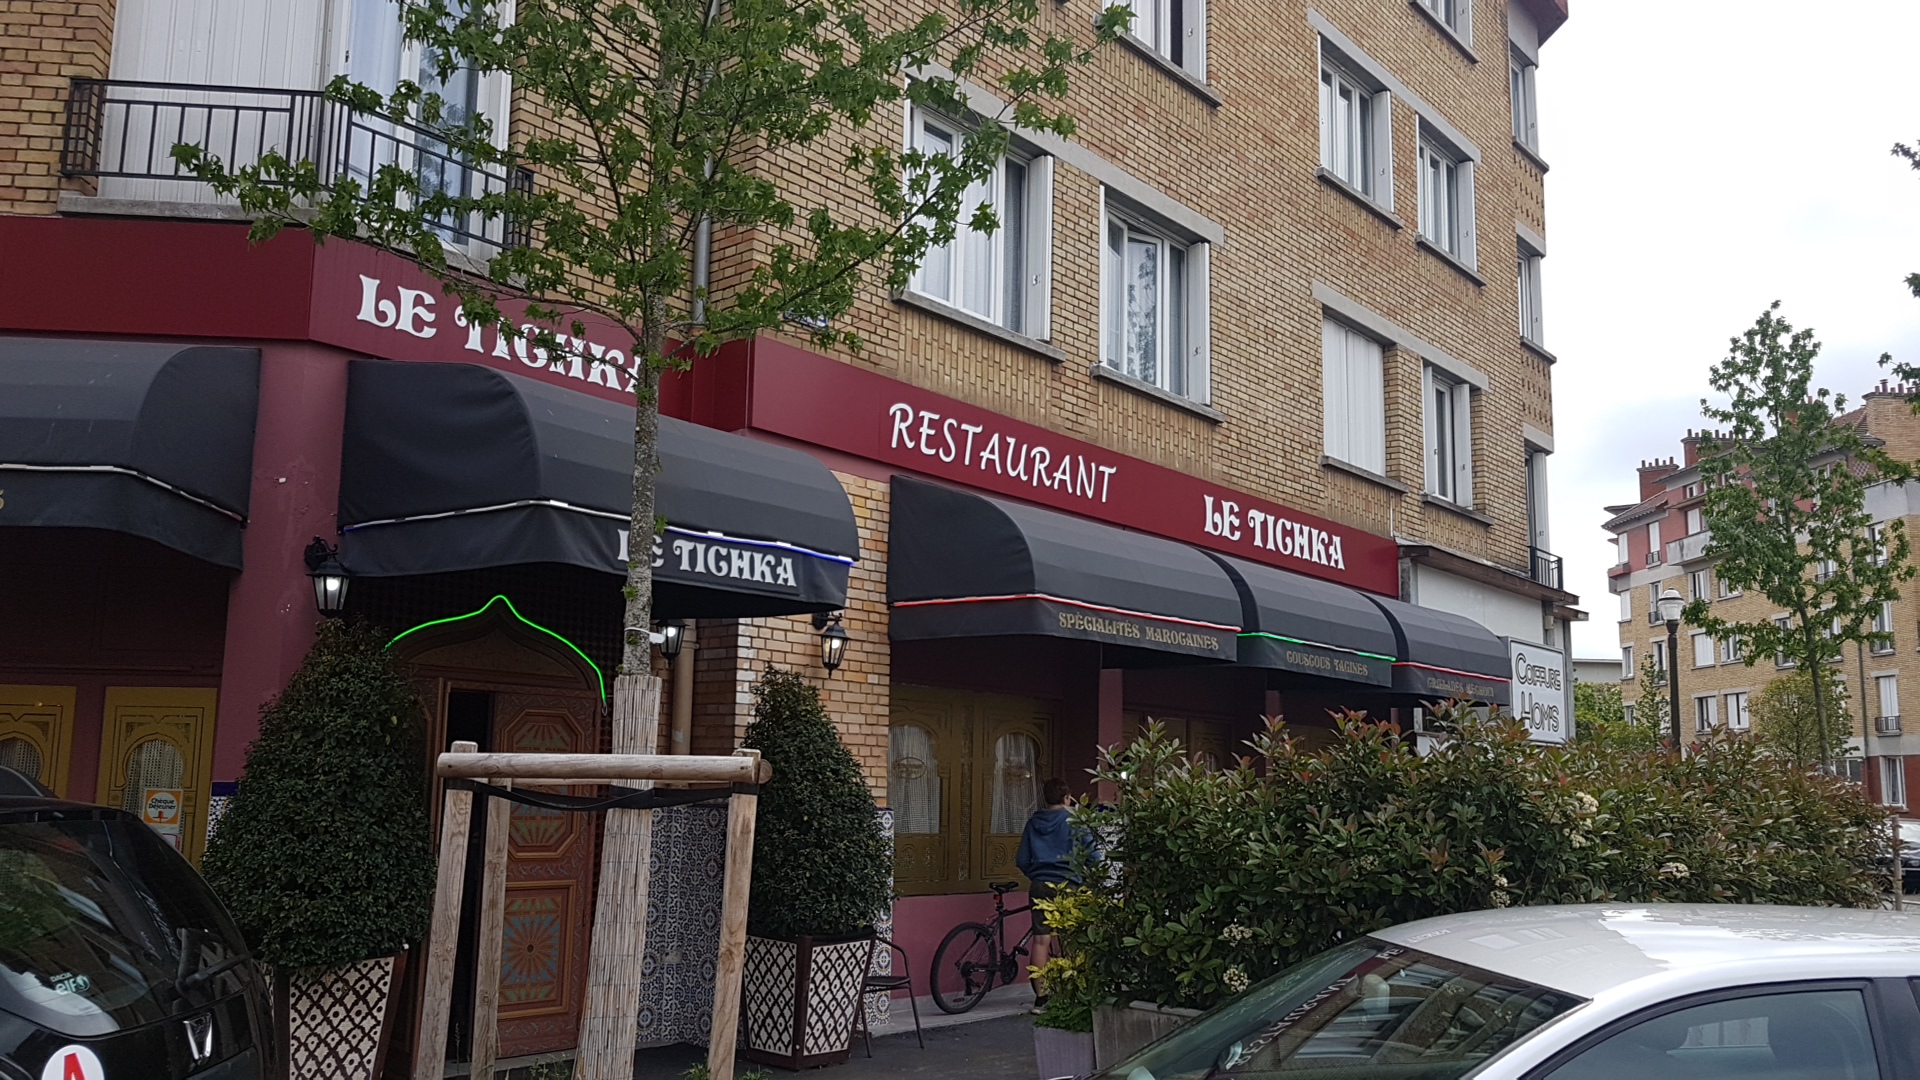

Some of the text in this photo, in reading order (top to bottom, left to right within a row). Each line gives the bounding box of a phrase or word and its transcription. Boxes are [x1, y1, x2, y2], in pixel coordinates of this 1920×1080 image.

[356, 273, 437, 339] LE
[888, 402, 1117, 503] RESTAURANT
[1203, 494, 1346, 571] LE TICHKA
[672, 539, 797, 587] TICHKA
[1058, 611, 1219, 651] SPÉCIALITÉS MAROCAINES
[151, 797, 175, 806] Chèque
[50, 972, 73, 982] DACIA
